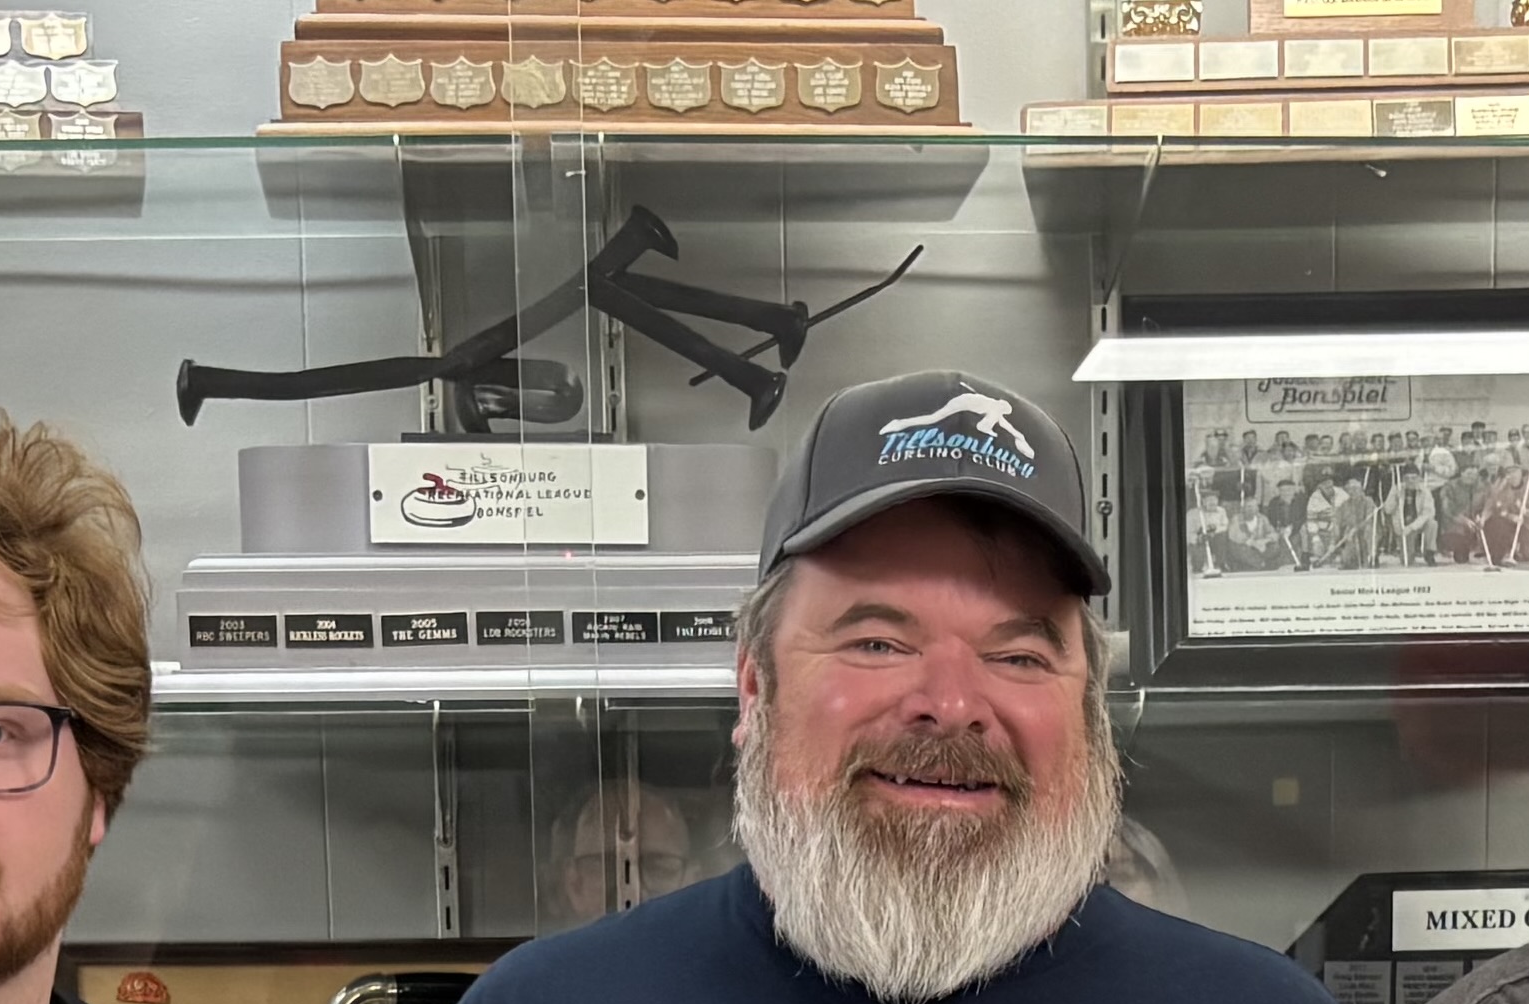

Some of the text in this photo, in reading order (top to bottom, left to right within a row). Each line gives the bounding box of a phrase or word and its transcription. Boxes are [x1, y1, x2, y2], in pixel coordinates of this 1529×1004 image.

[878, 447, 1017, 477] CURLING CLUB
[219, 631, 270, 642] SWEEPERS
[392, 630, 414, 641] THE
[1425, 909, 1517, 931] MIXED
